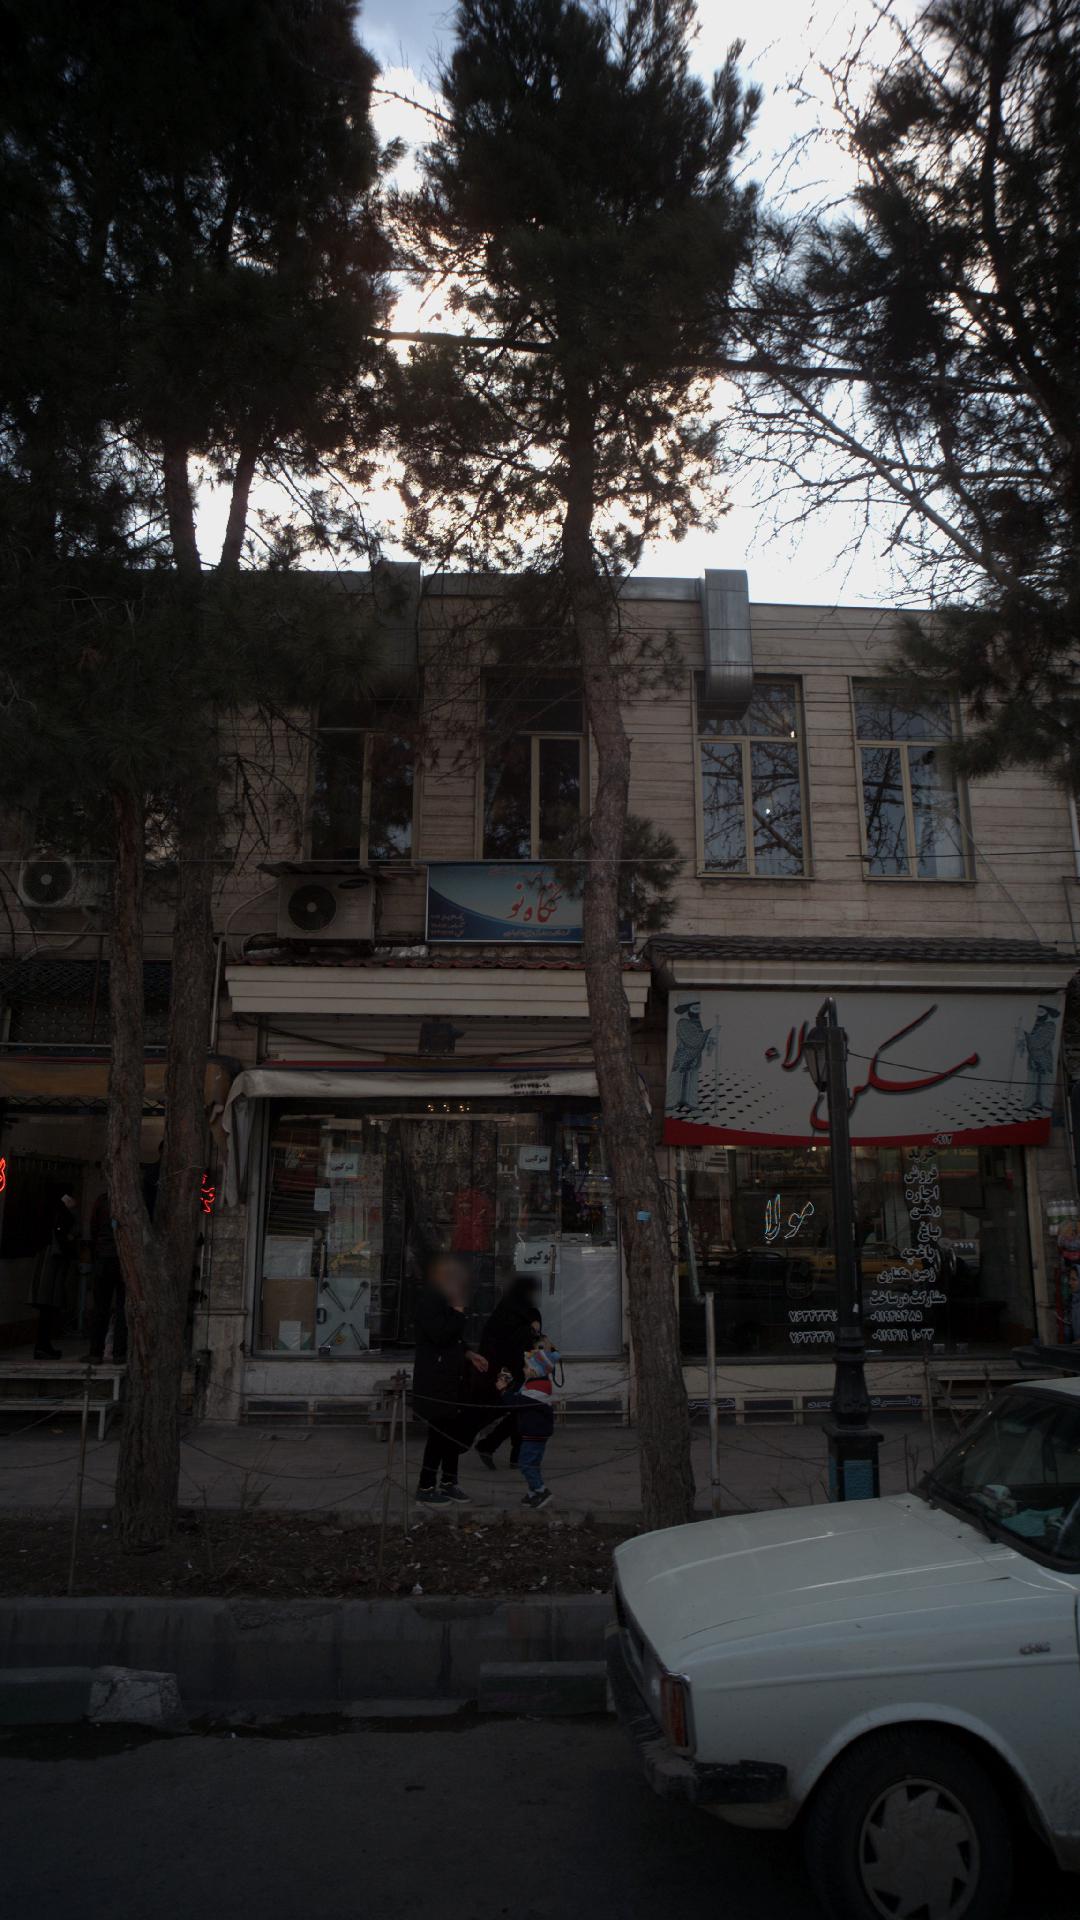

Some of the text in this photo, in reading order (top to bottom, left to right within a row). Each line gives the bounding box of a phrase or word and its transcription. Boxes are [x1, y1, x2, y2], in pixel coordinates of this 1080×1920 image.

[904, 1164, 939, 1184] فروش
[905, 1185, 940, 1203] اجاره
[917, 1221, 942, 1242] باغ
[901, 1244, 936, 1265] باغچه
[912, 1267, 937, 1283] زمین
[869, 1290, 947, 1308] مشارکت در ساخت
